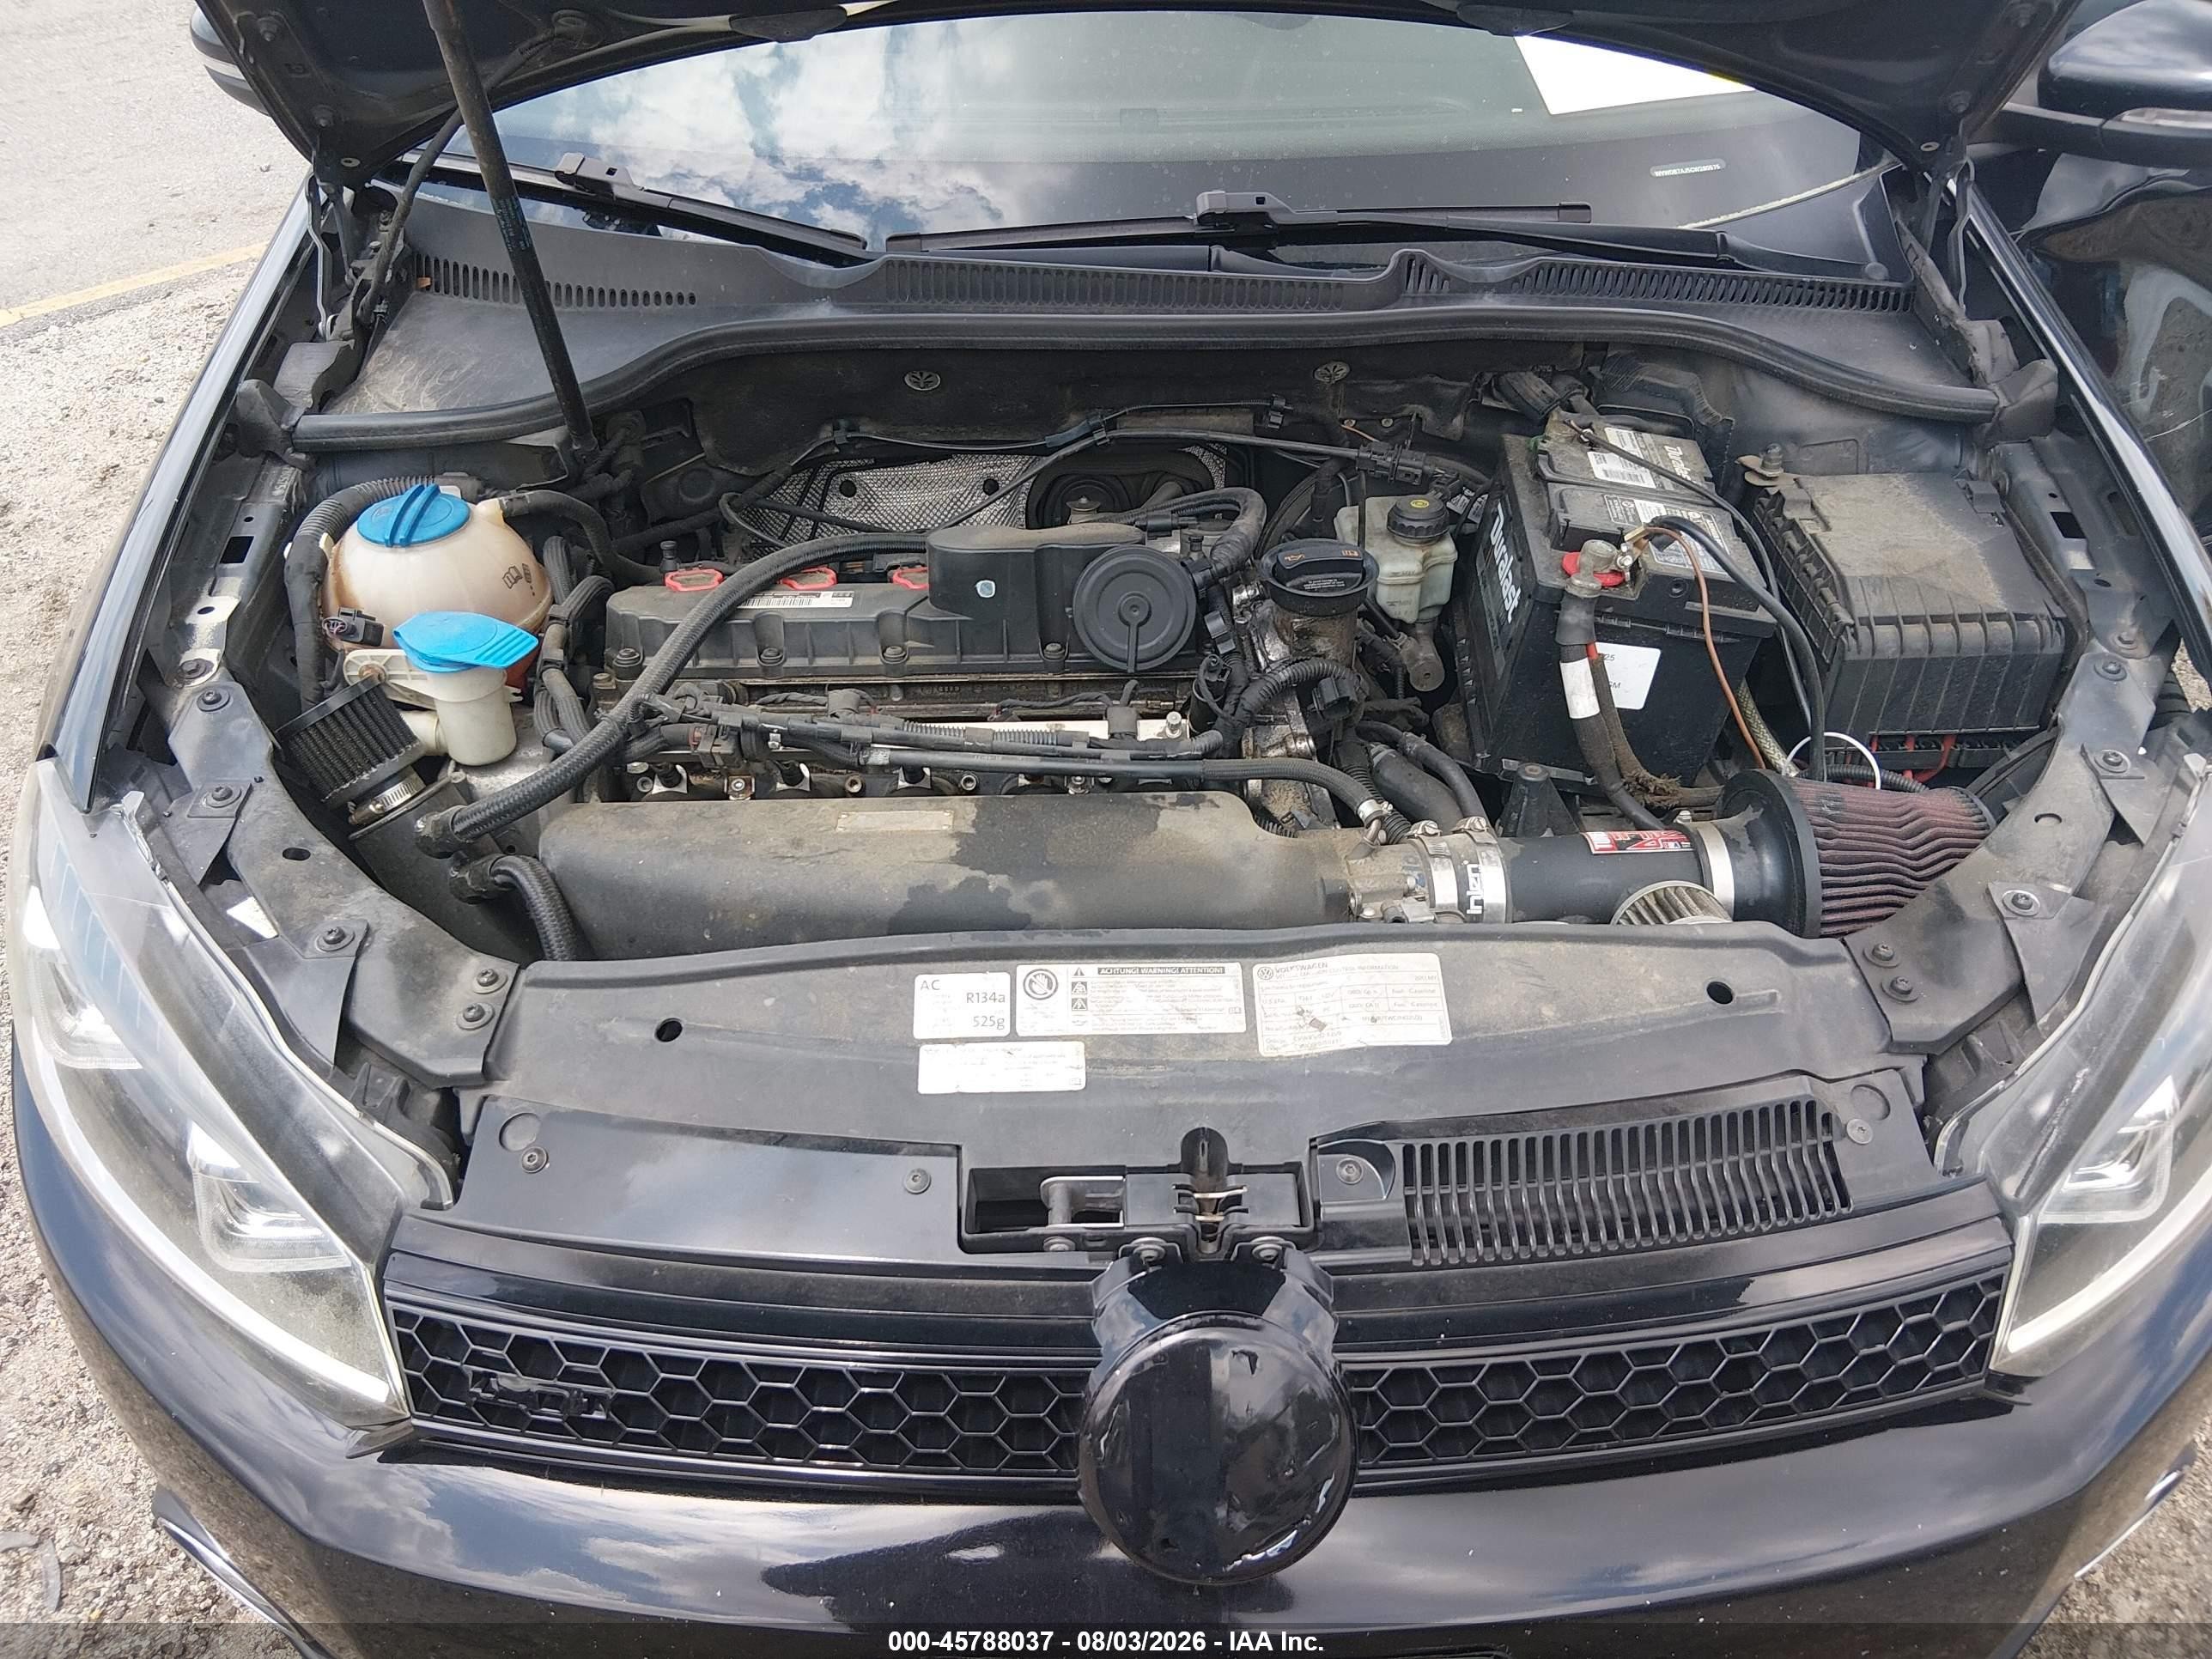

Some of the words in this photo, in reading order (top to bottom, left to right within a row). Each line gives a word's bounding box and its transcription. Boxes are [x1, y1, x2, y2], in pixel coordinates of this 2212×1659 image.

[1490, 499, 1522, 624] Duralast
[1275, 962, 1328, 974] VOLKSWAGEN
[920, 979, 941, 991] AC
[966, 991, 1006, 1004] R134a
[972, 1016, 1006, 1030] 525g
